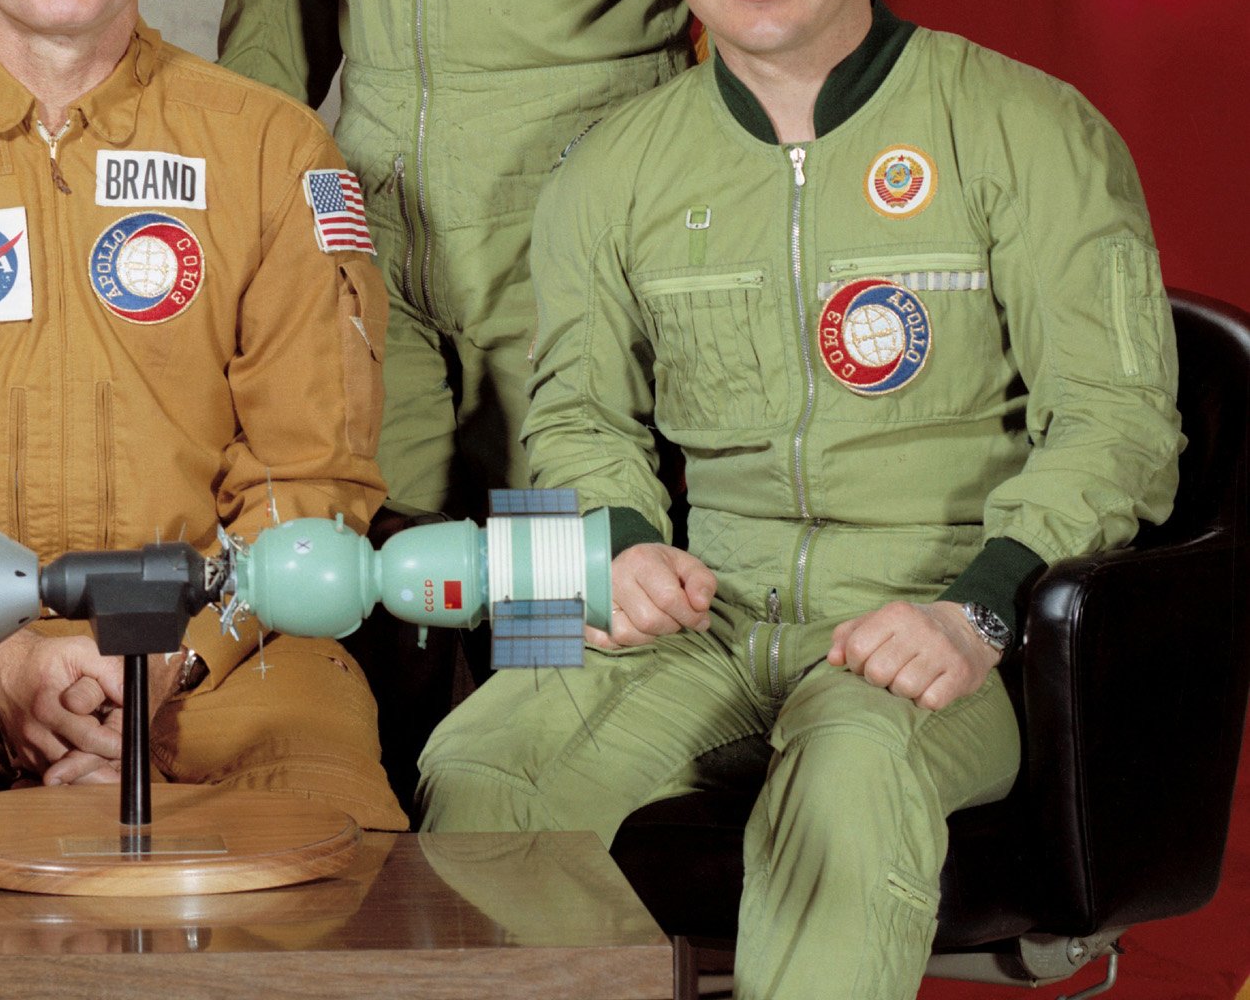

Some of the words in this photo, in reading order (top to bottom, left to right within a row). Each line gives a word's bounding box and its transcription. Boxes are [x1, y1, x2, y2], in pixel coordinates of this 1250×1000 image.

[105, 158, 197, 202] BRAND
[97, 229, 127, 300] APOLLO
[170, 238, 199, 305] СОЮЗ
[823, 311, 856, 378] СОЮЗ
[886, 290, 926, 363] APOLLO
[425, 580, 434, 612] СССР
